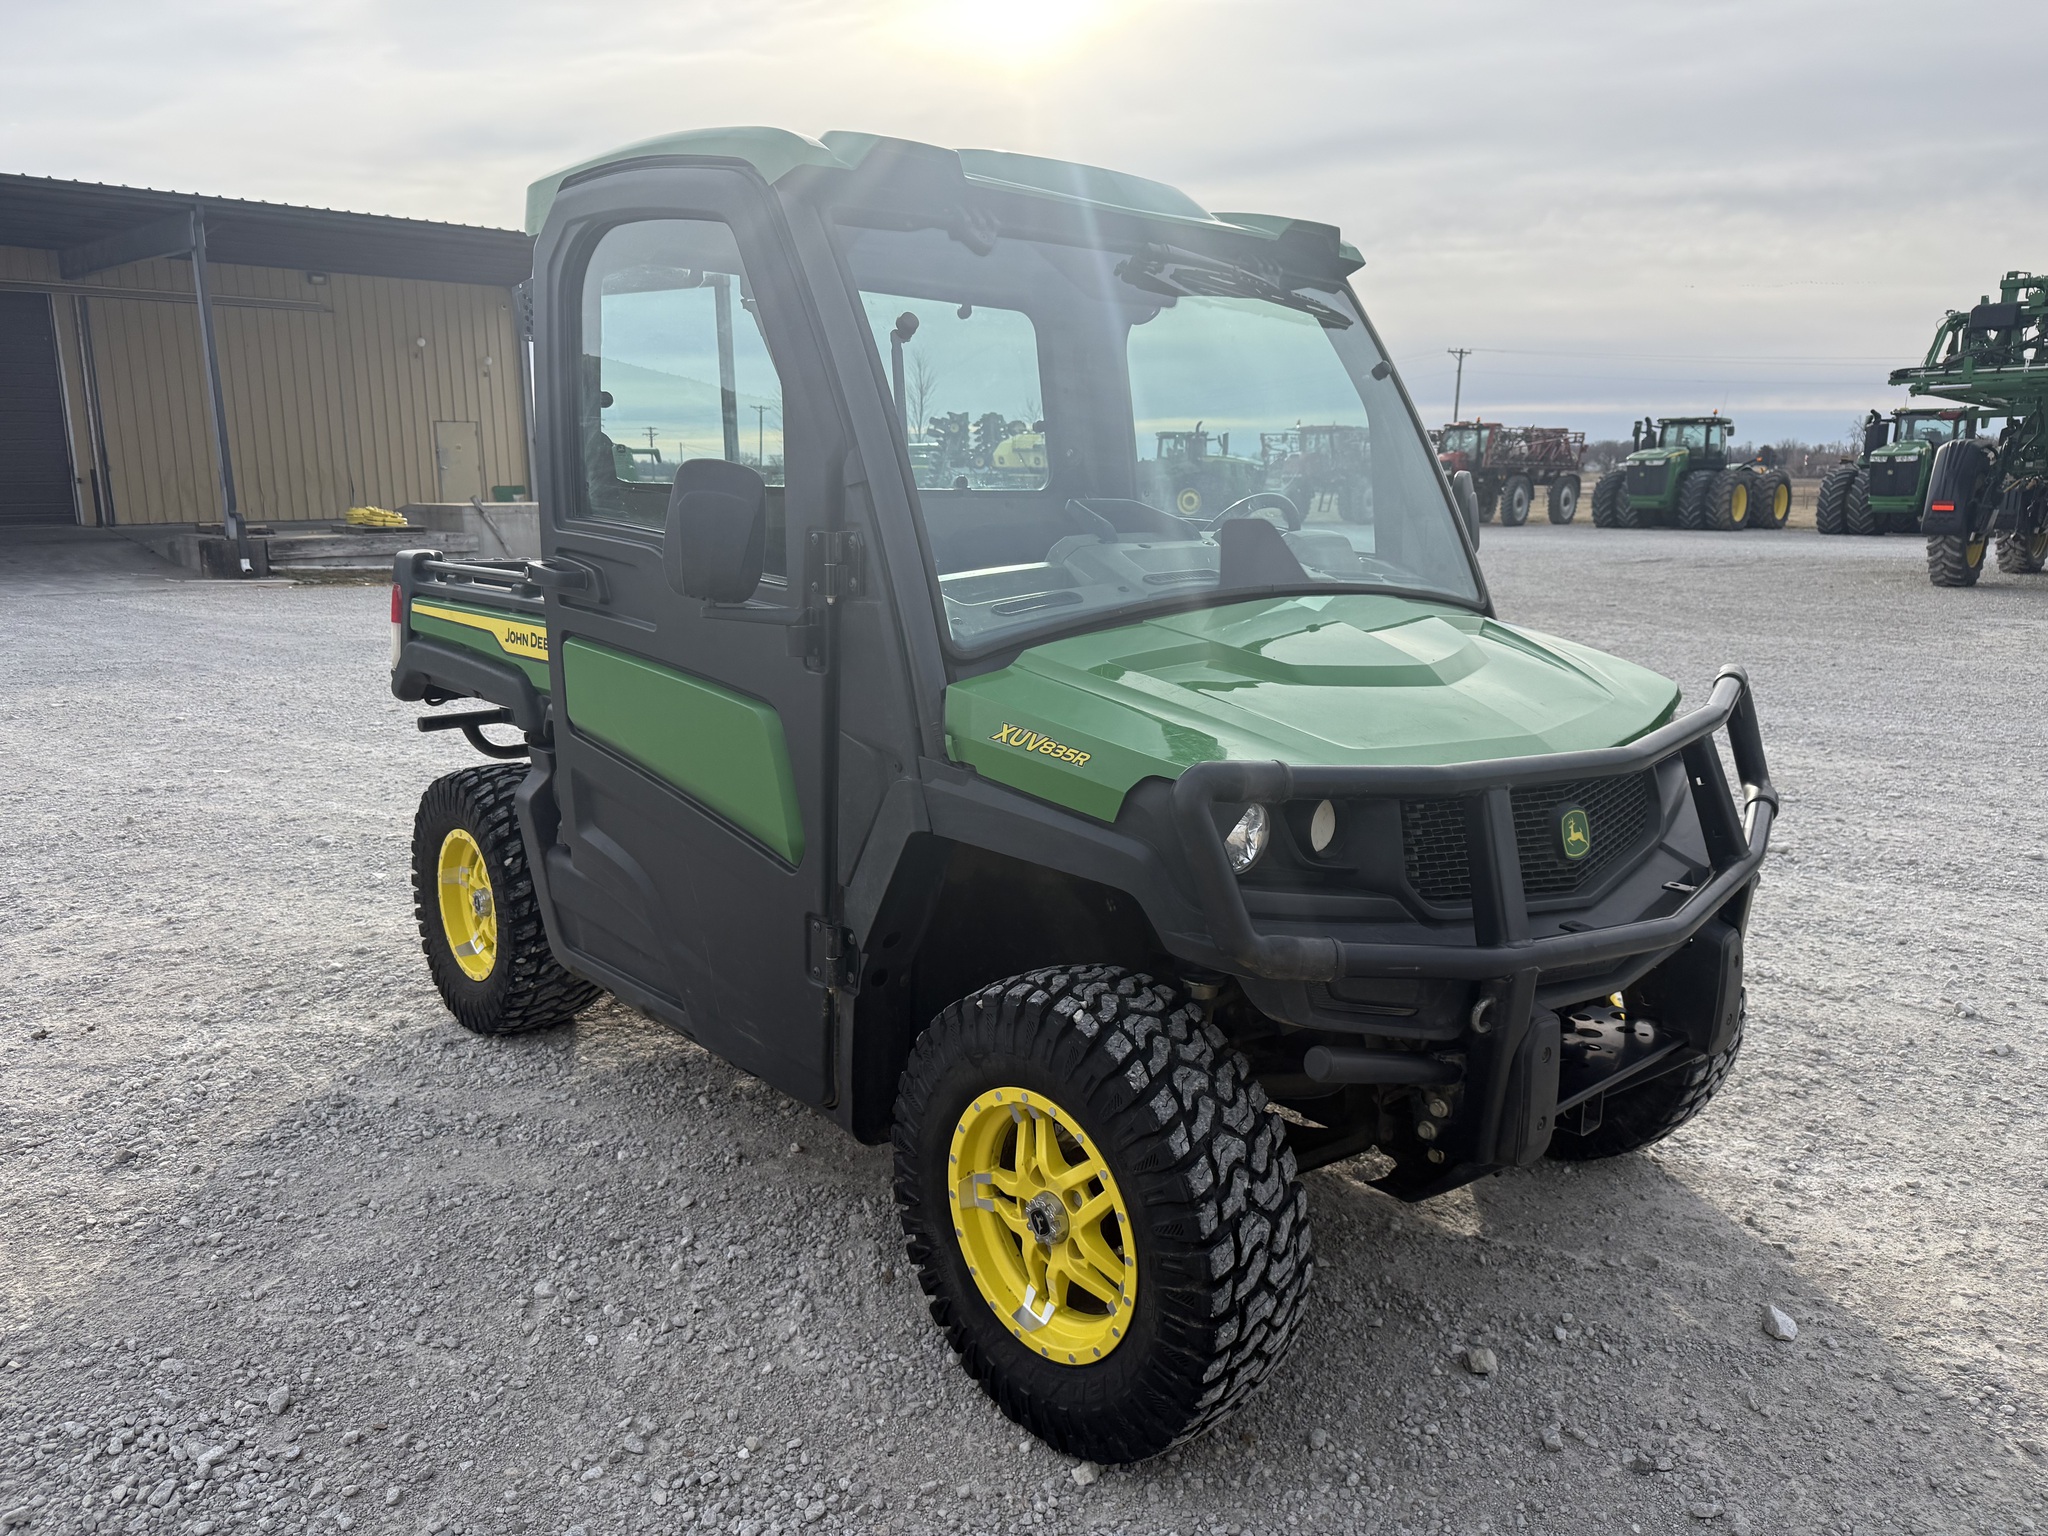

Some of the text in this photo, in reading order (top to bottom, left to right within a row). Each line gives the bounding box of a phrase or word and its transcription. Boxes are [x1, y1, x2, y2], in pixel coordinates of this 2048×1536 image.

[505, 628, 549, 650] JOHN DEE
[990, 722, 1092, 767] XUV835R
